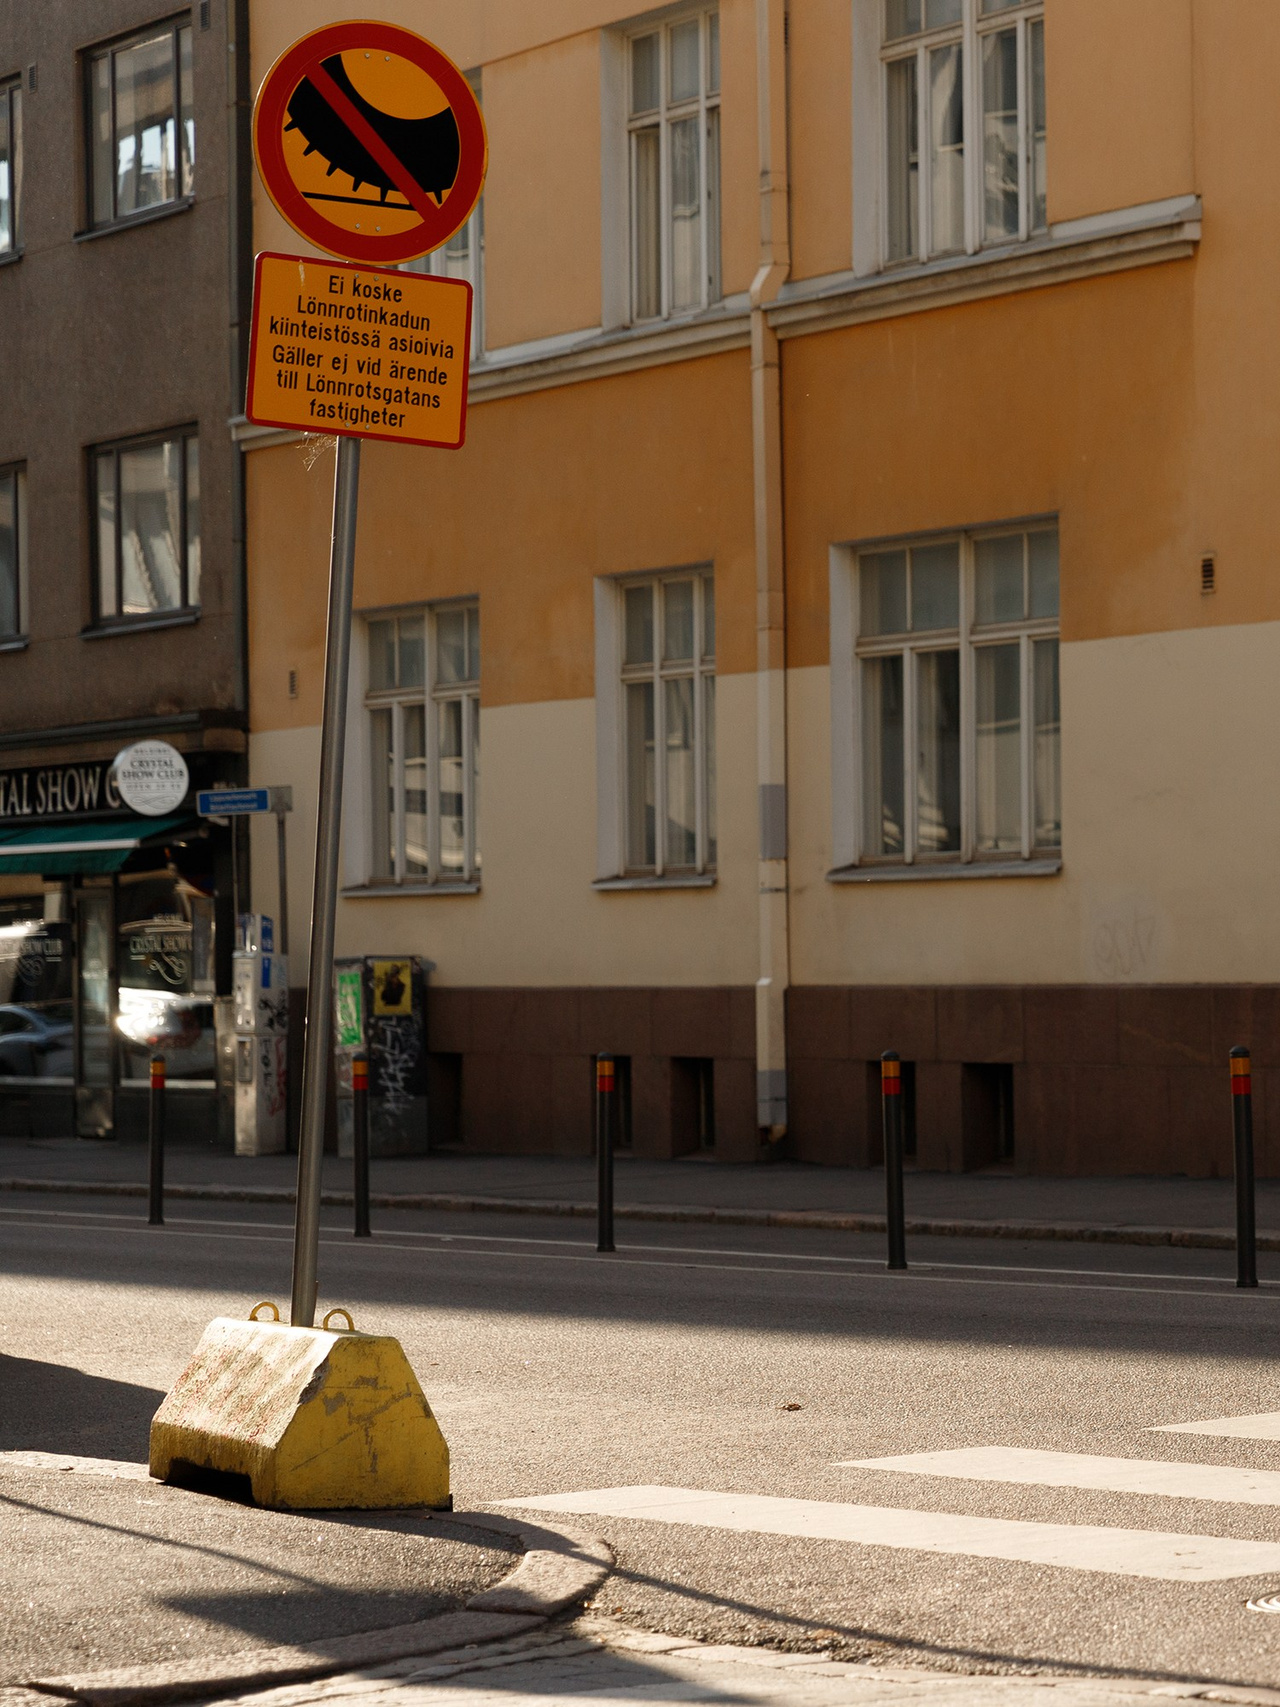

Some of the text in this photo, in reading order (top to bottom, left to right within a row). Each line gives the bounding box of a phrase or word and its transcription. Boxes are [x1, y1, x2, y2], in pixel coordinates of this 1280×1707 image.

[328, 275, 403, 303] Ei koske
[297, 295, 431, 332] Lönnrotinkadun
[269, 315, 454, 359] kiinteistössä asioivia
[272, 344, 448, 385] Gäller ej vid ärende
[276, 369, 441, 409] till Lönnrotsgatans
[309, 398, 406, 428] fastigheter
[36, 765, 102, 815] SHOW
